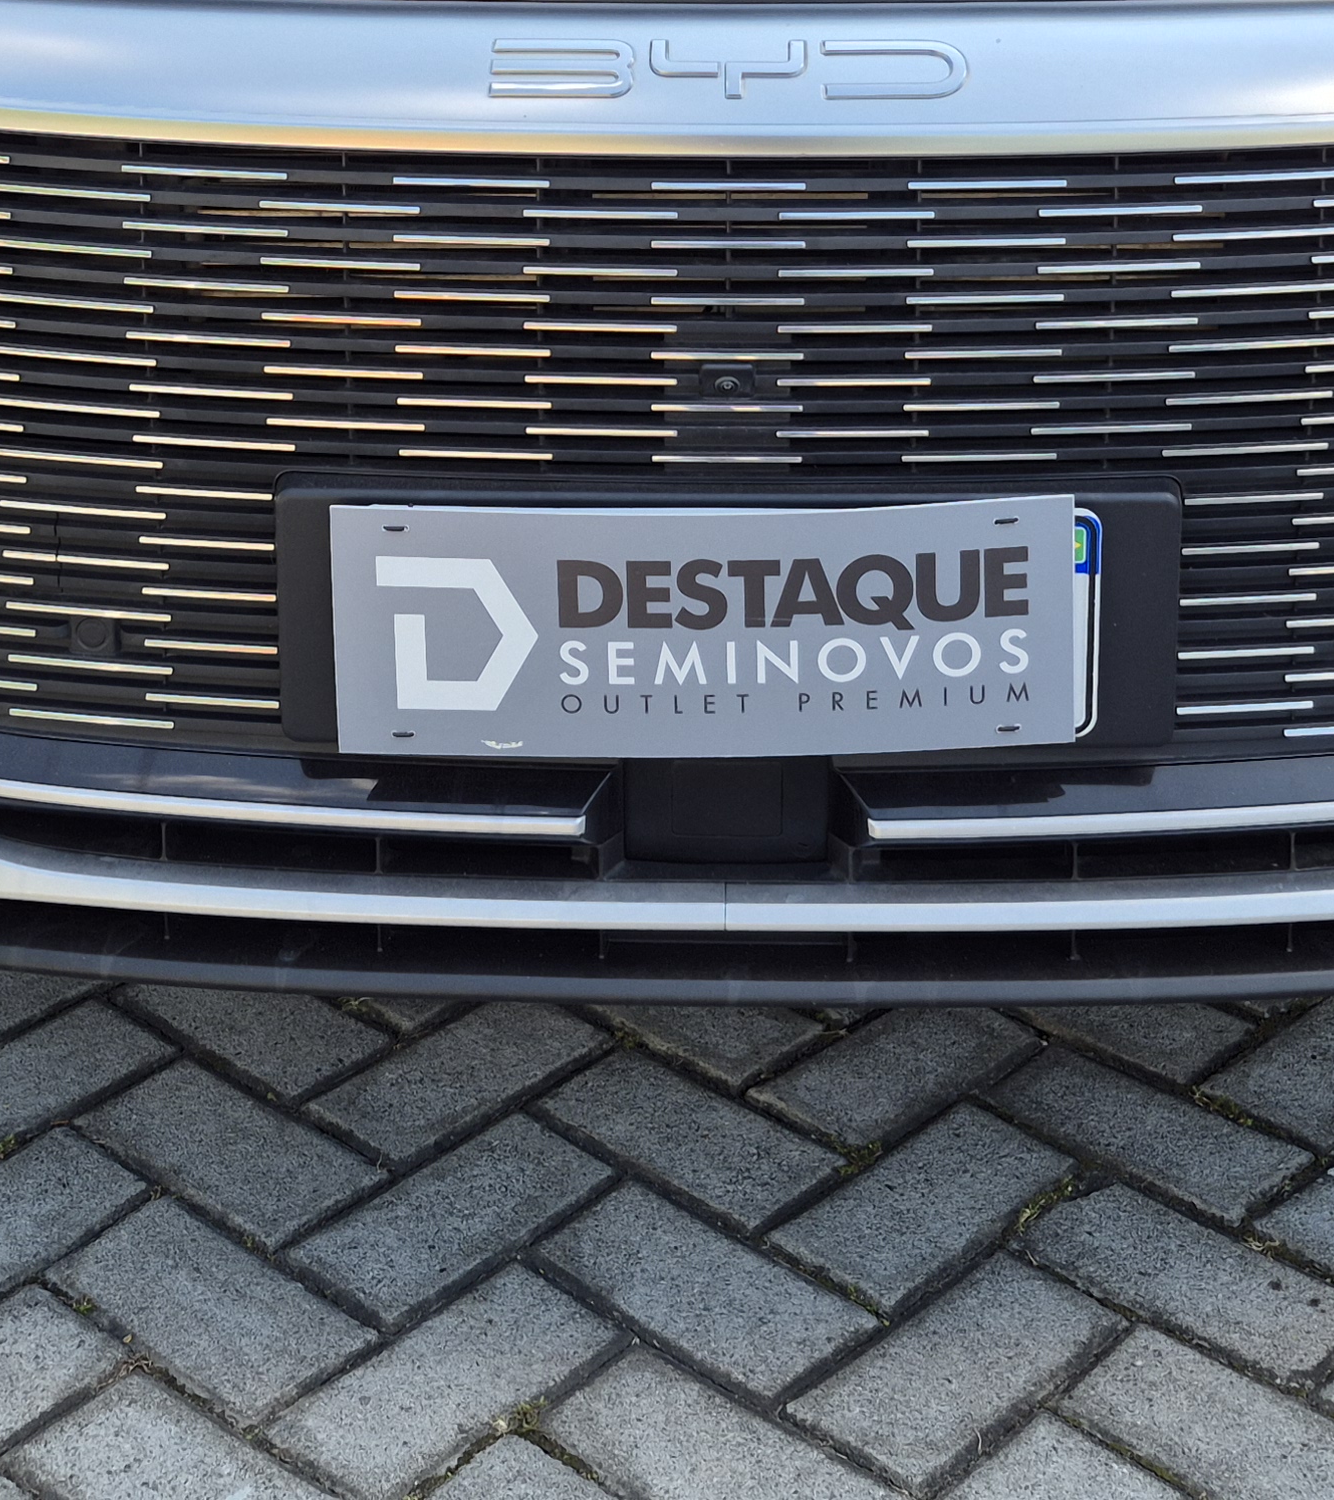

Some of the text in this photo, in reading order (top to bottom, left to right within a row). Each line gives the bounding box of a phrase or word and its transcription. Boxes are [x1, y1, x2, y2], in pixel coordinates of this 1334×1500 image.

[488, 38, 970, 99] BYD
[556, 546, 1029, 631] DESTAQUE
[559, 628, 1029, 686] SEMINOVOS
[560, 682, 1029, 716] OUTLET PREMIUM
